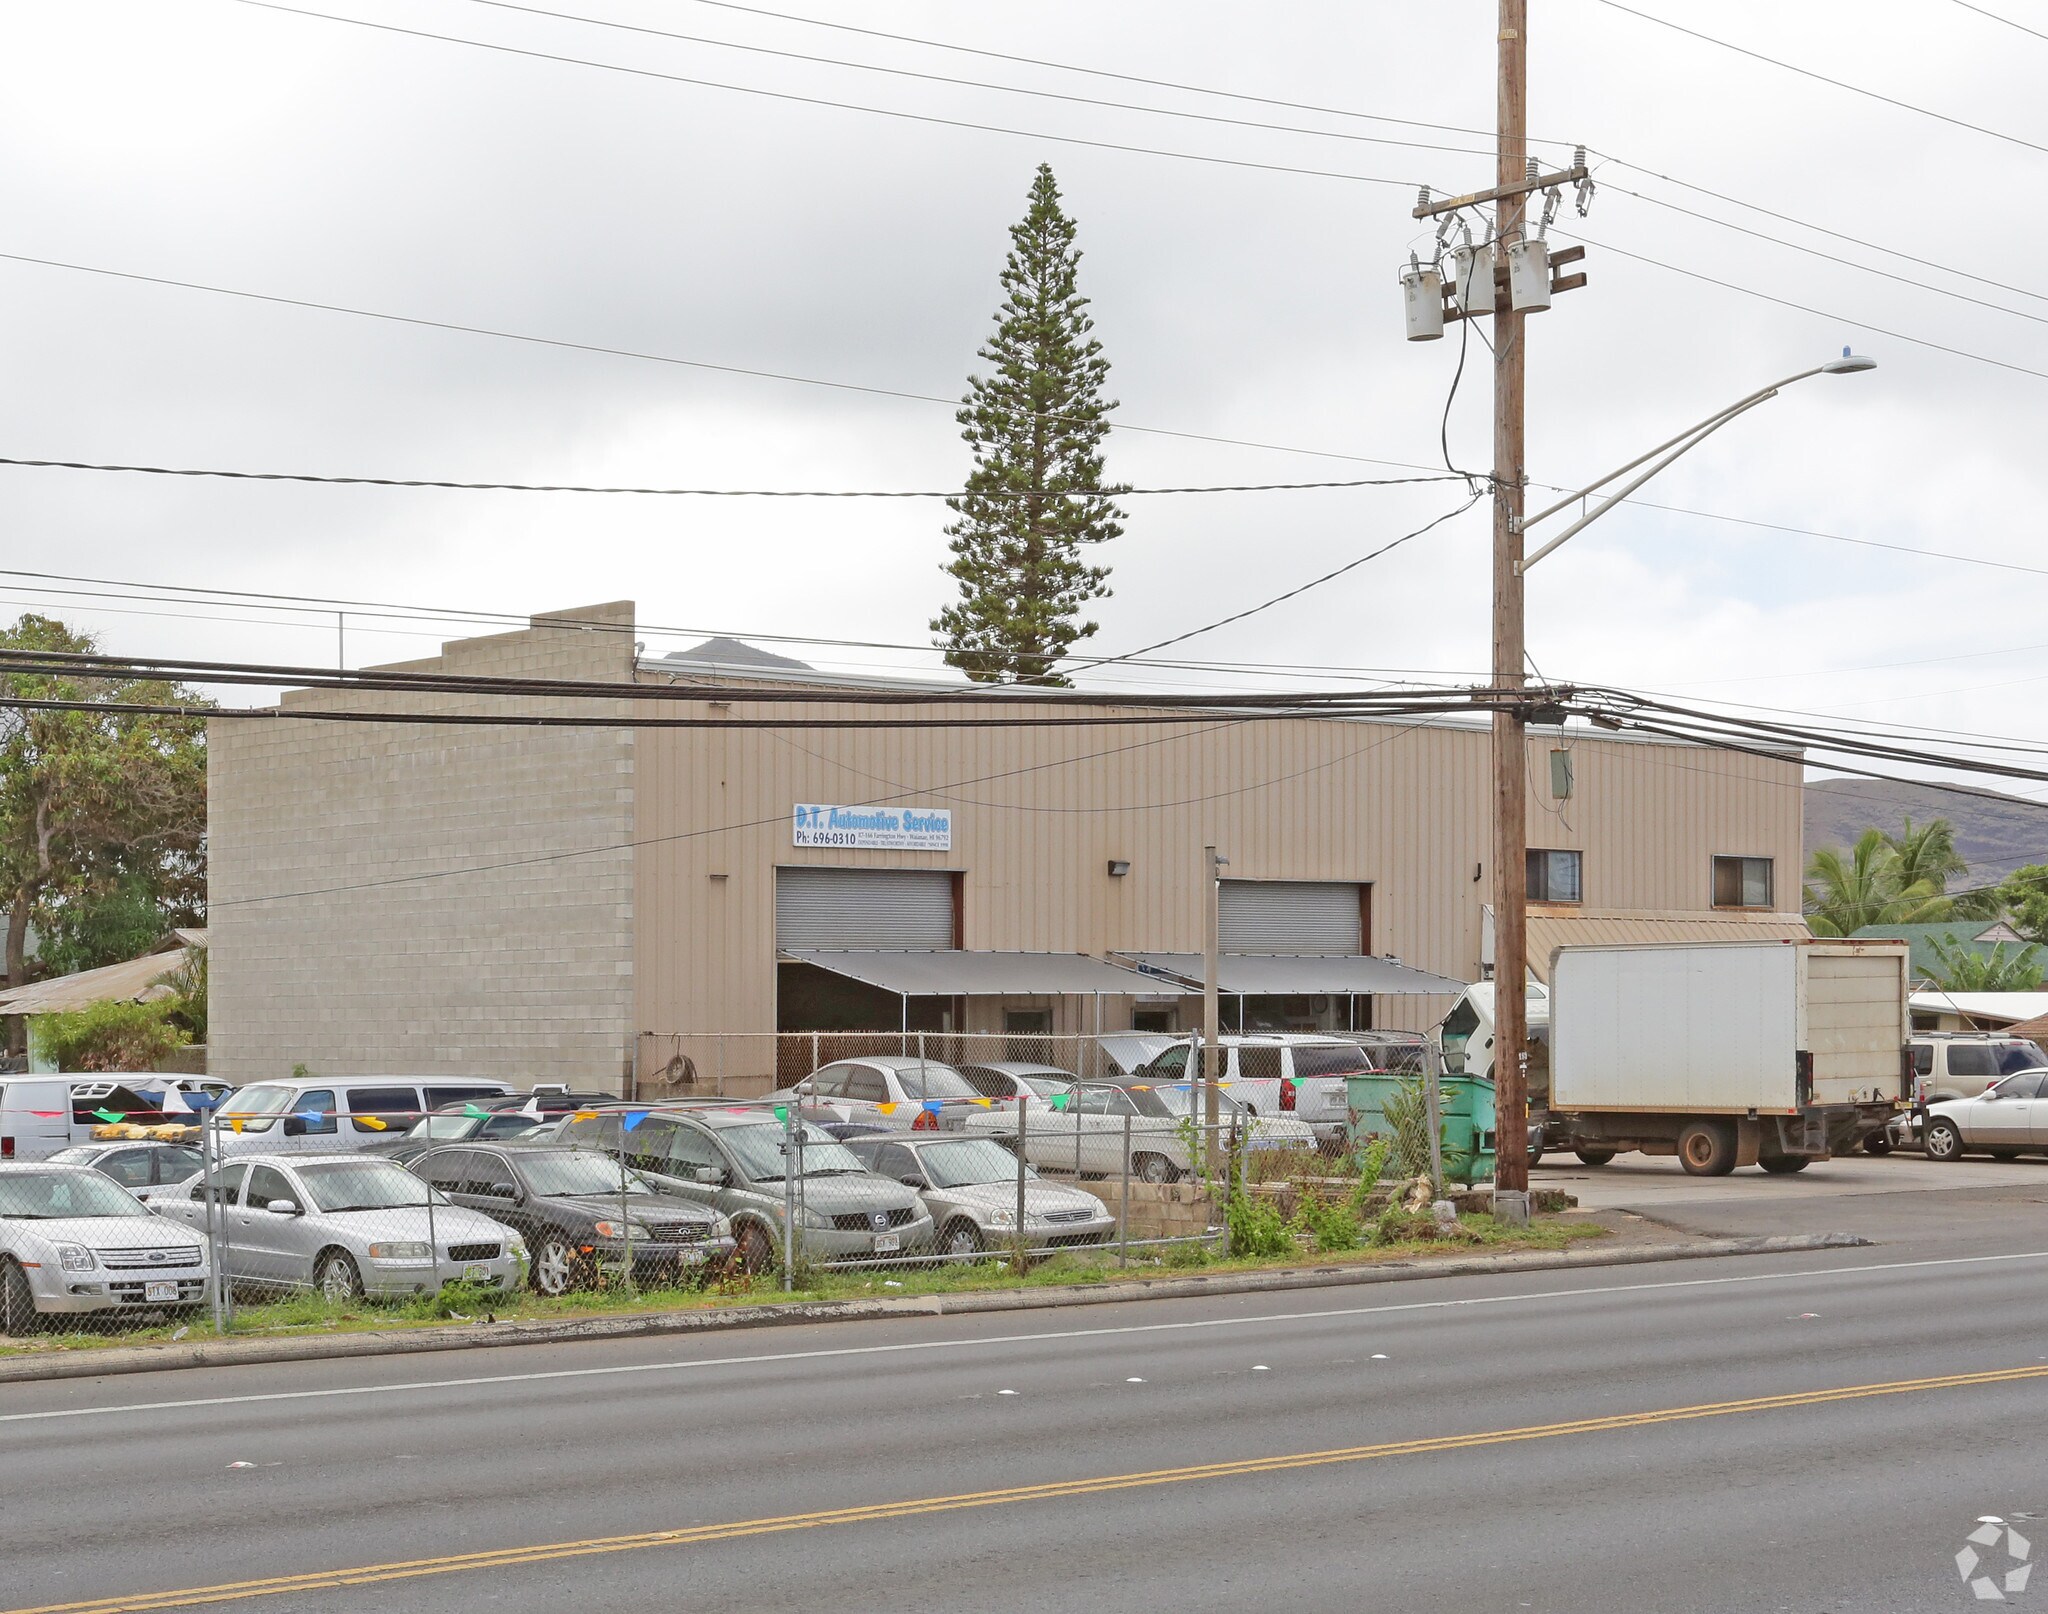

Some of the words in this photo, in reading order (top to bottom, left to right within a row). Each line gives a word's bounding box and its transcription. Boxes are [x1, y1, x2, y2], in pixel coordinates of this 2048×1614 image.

[796, 806, 824, 829] D.T.
[828, 807, 899, 831] Automotive
[903, 810, 949, 833] Service
[796, 831, 809, 843] Ph:
[813, 832, 856, 844] 696-0310
